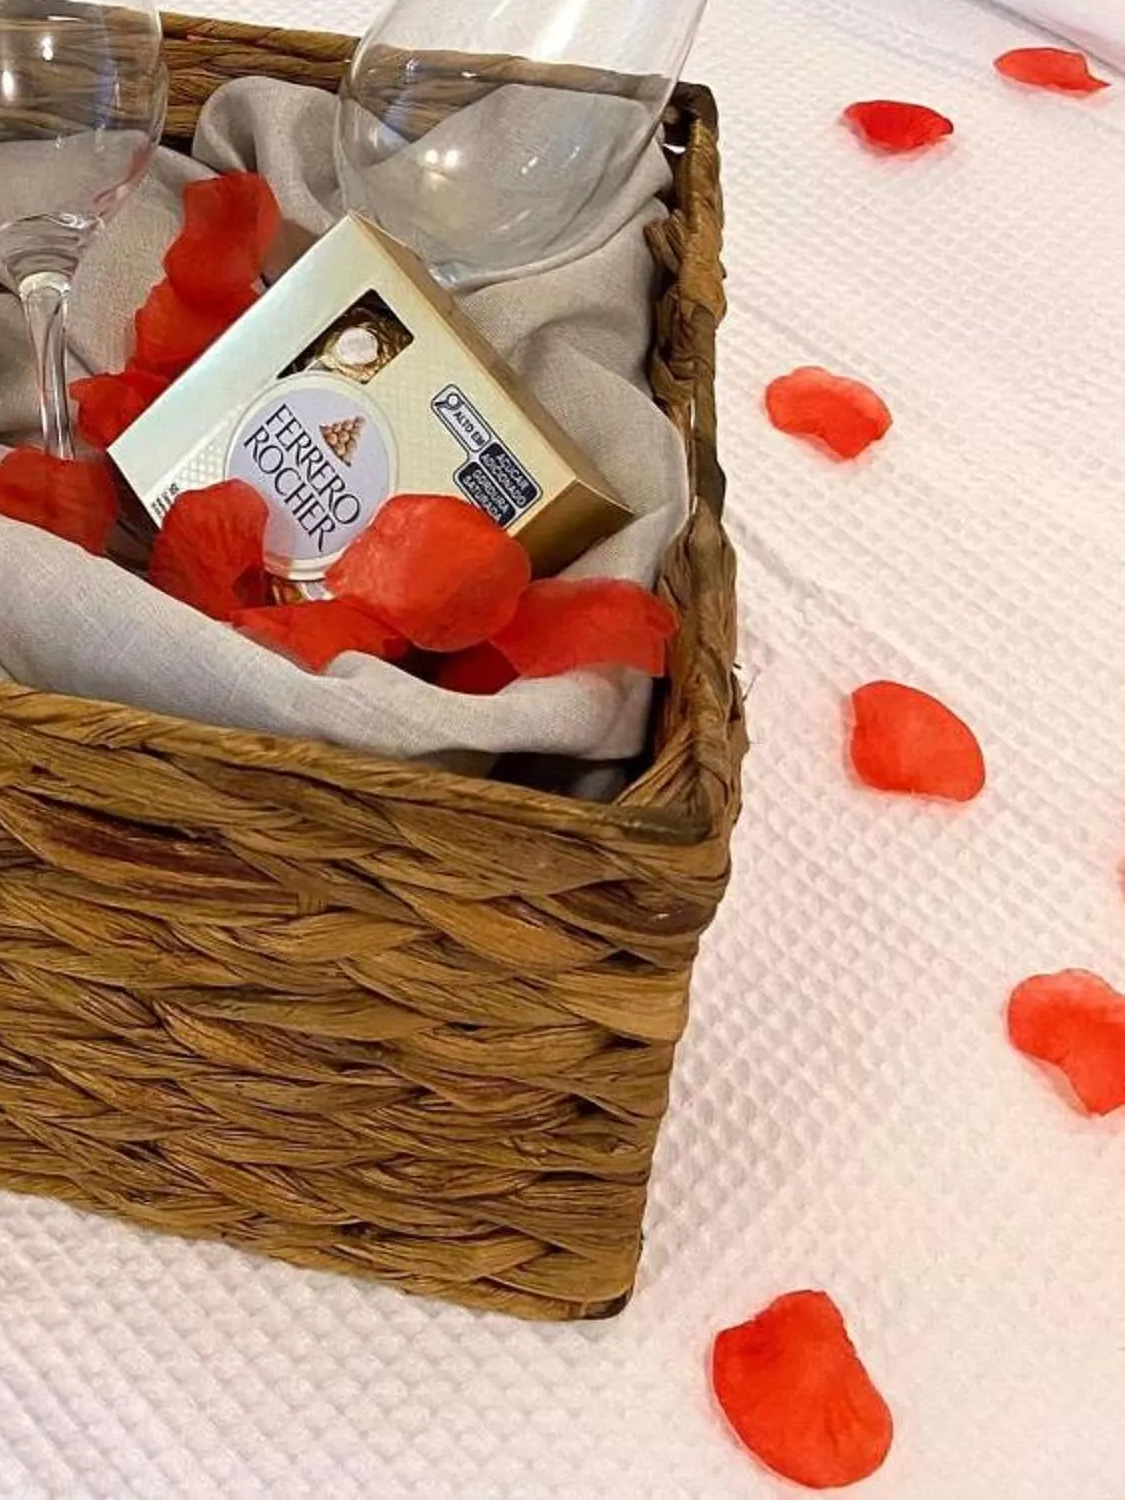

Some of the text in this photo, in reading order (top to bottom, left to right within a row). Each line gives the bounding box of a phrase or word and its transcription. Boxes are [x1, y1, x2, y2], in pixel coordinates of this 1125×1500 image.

[453, 411, 485, 446] ALTO EM
[243, 425, 337, 553] ROCHER
[265, 403, 361, 525] FERRERO
[480, 453, 526, 506] ADICIONADO
[472, 469, 510, 514] GORDURA
